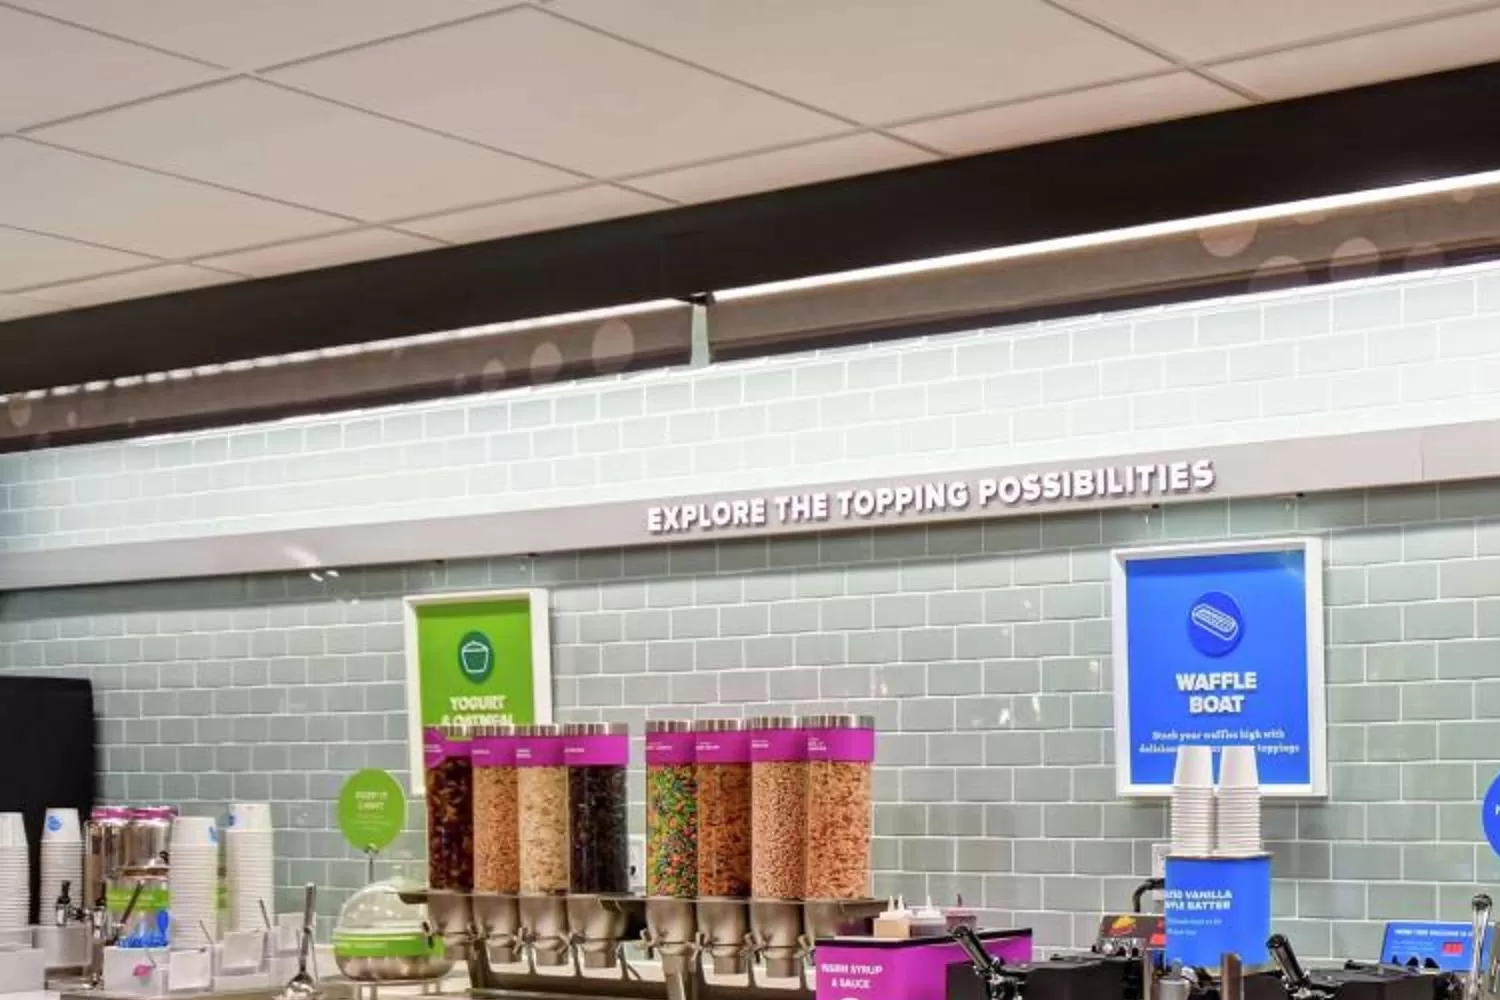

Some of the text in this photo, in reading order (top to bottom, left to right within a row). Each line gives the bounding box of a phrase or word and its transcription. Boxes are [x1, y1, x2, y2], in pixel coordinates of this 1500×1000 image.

[647, 460, 1215, 532] EXPLORE THE TOPPING POSSIBILITIES
[1175, 671, 1257, 692] WAFFLE
[449, 694, 507, 711] YOGURT
[1189, 695, 1244, 714] BOAT
[1186, 889, 1233, 899] VANILLA
[851, 963, 883, 975] SYRUP
